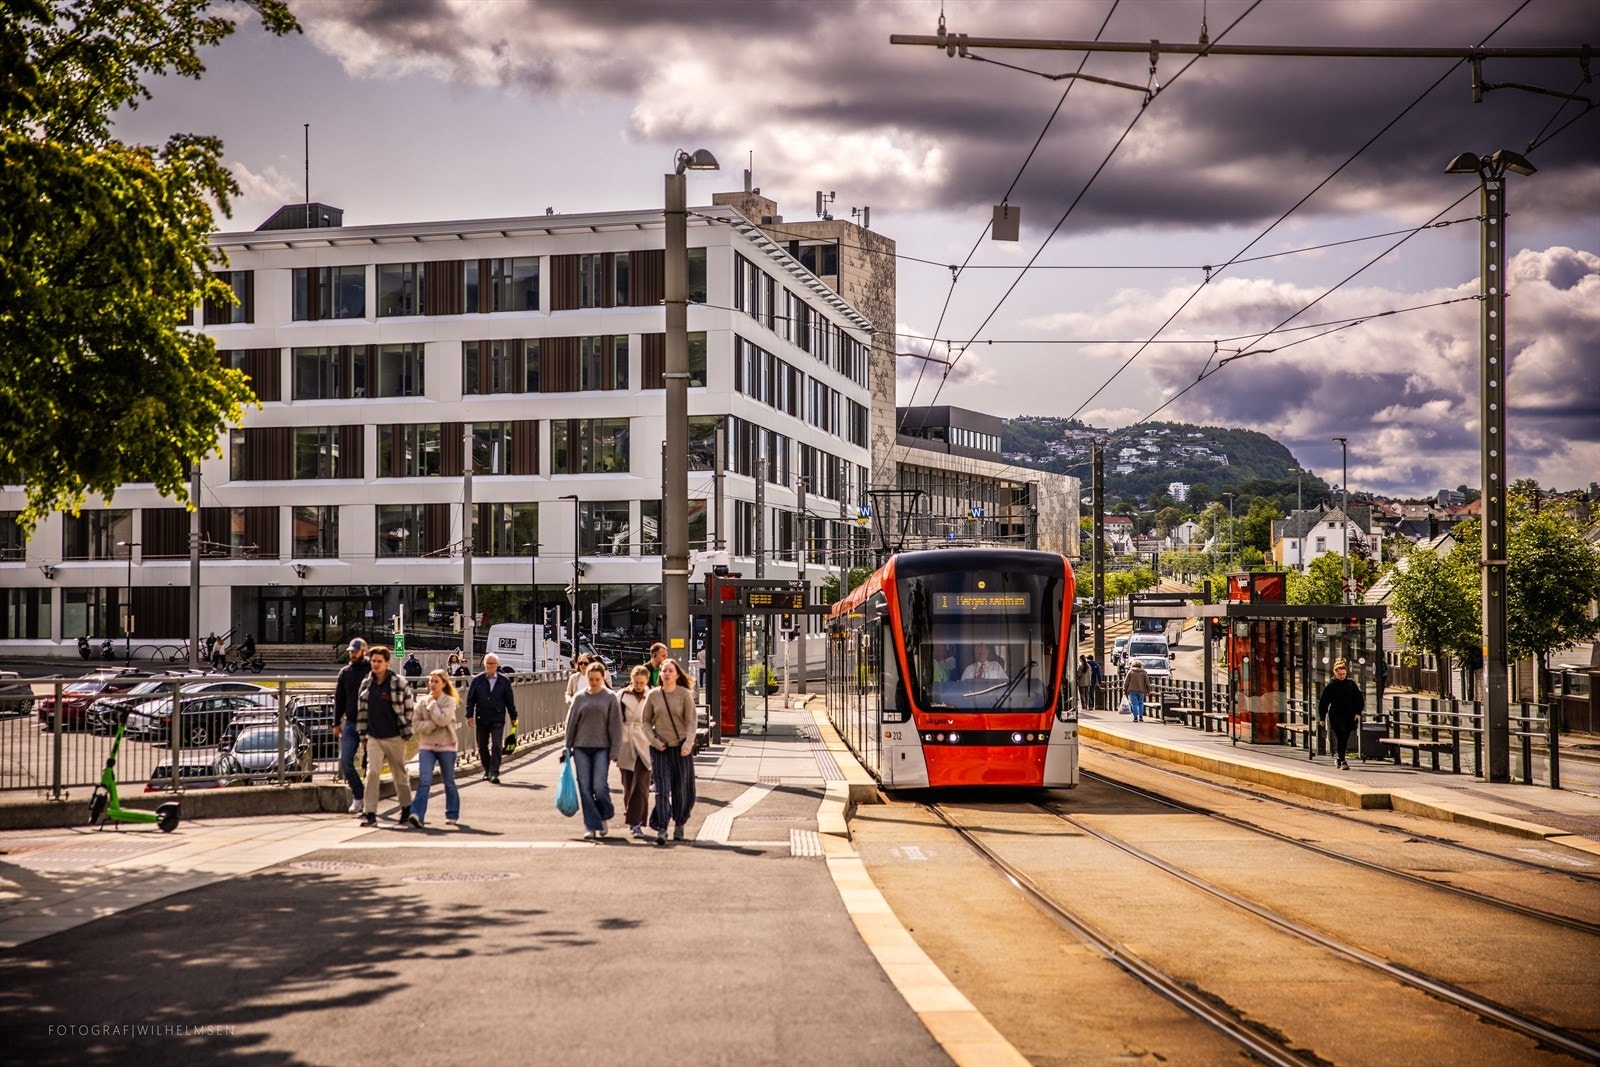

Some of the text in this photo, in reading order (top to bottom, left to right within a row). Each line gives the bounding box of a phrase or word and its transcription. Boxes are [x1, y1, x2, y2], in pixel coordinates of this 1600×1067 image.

[860, 507, 871, 516] W
[971, 508, 982, 518] W
[329, 615, 338, 626] M
[499, 638, 516, 648] P&P
[892, 731, 902, 741] 212
